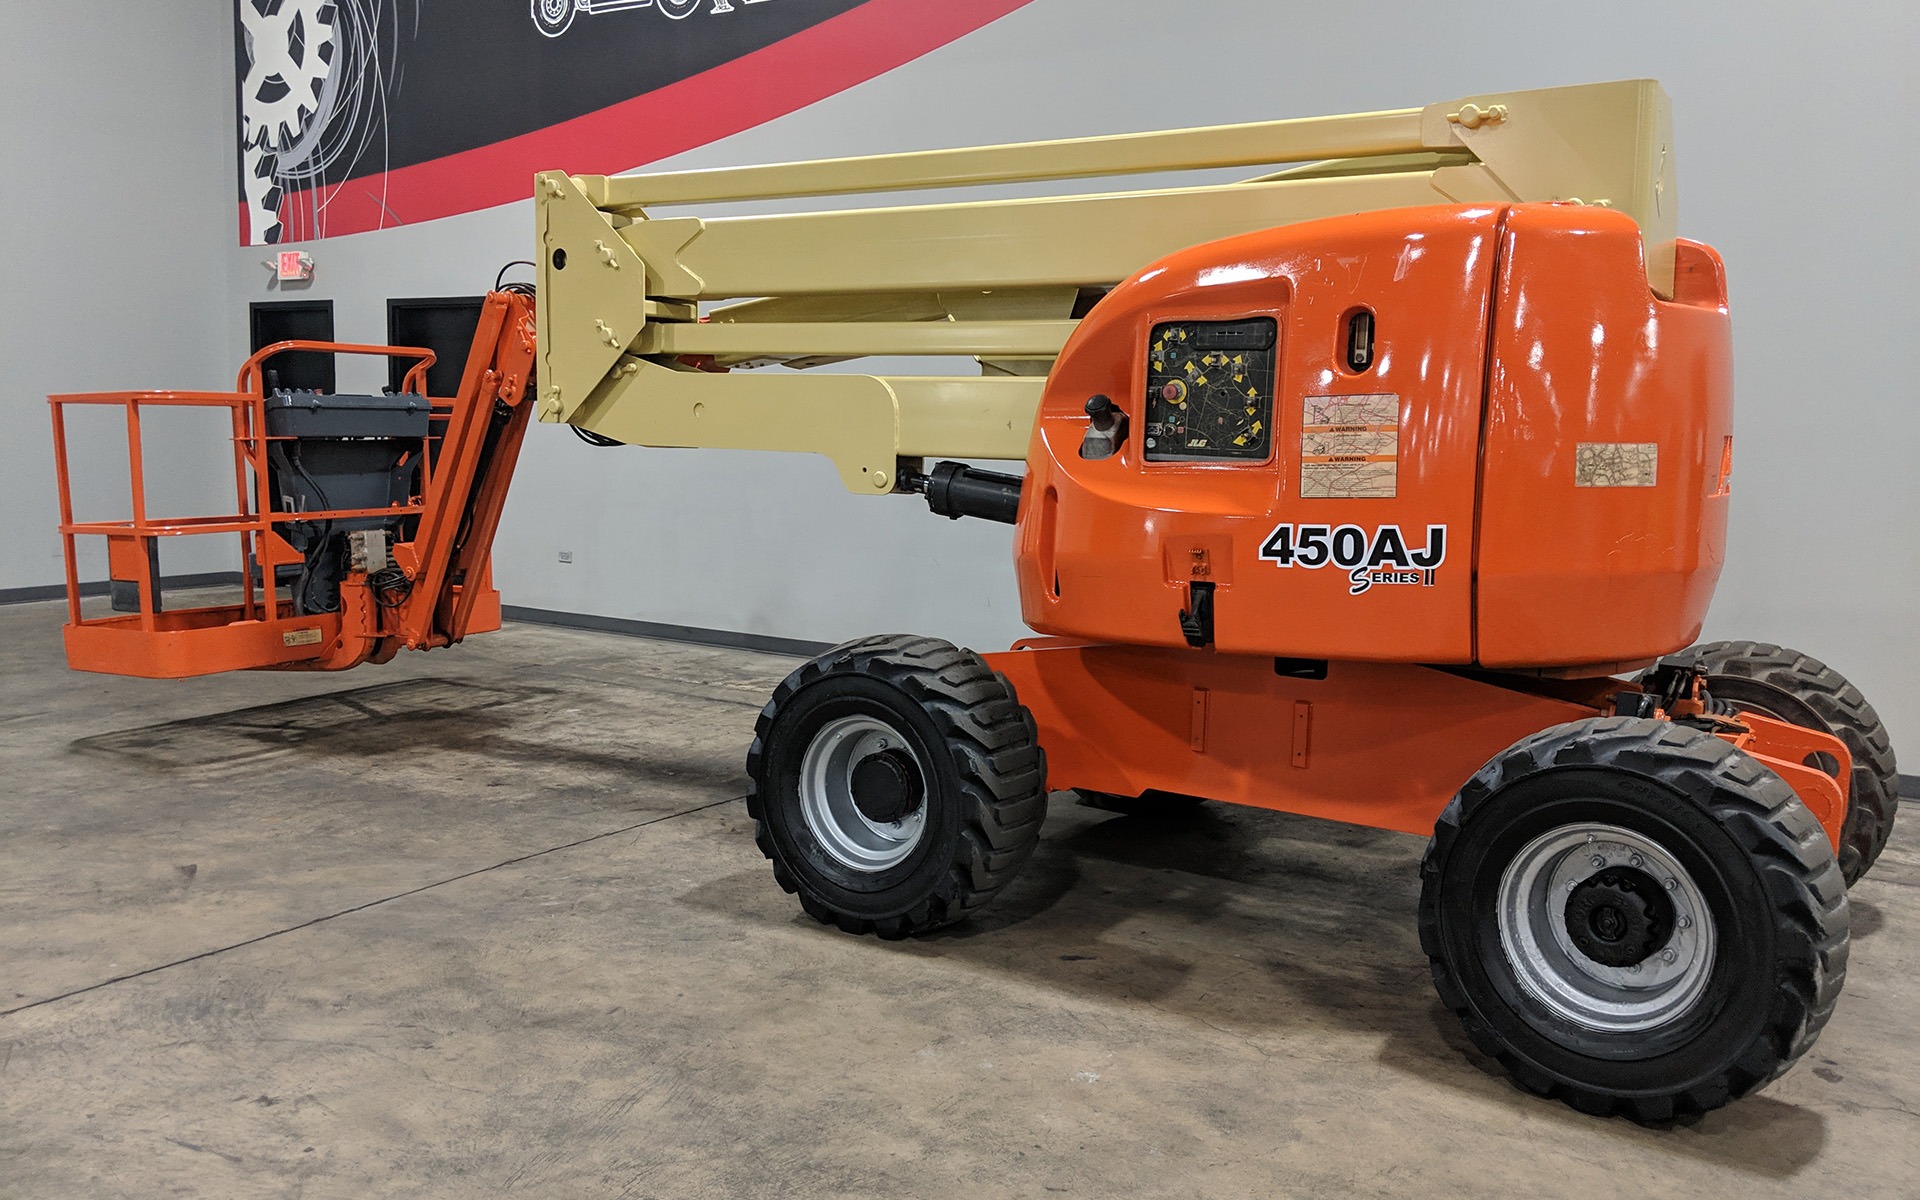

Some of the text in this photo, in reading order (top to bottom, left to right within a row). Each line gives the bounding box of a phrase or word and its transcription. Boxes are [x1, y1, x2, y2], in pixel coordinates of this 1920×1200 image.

[281, 252, 300, 276] EXIT
[1186, 438, 1208, 448] JLG
[1259, 524, 1447, 569] 450AJ
[1423, 569, 1436, 586] II
